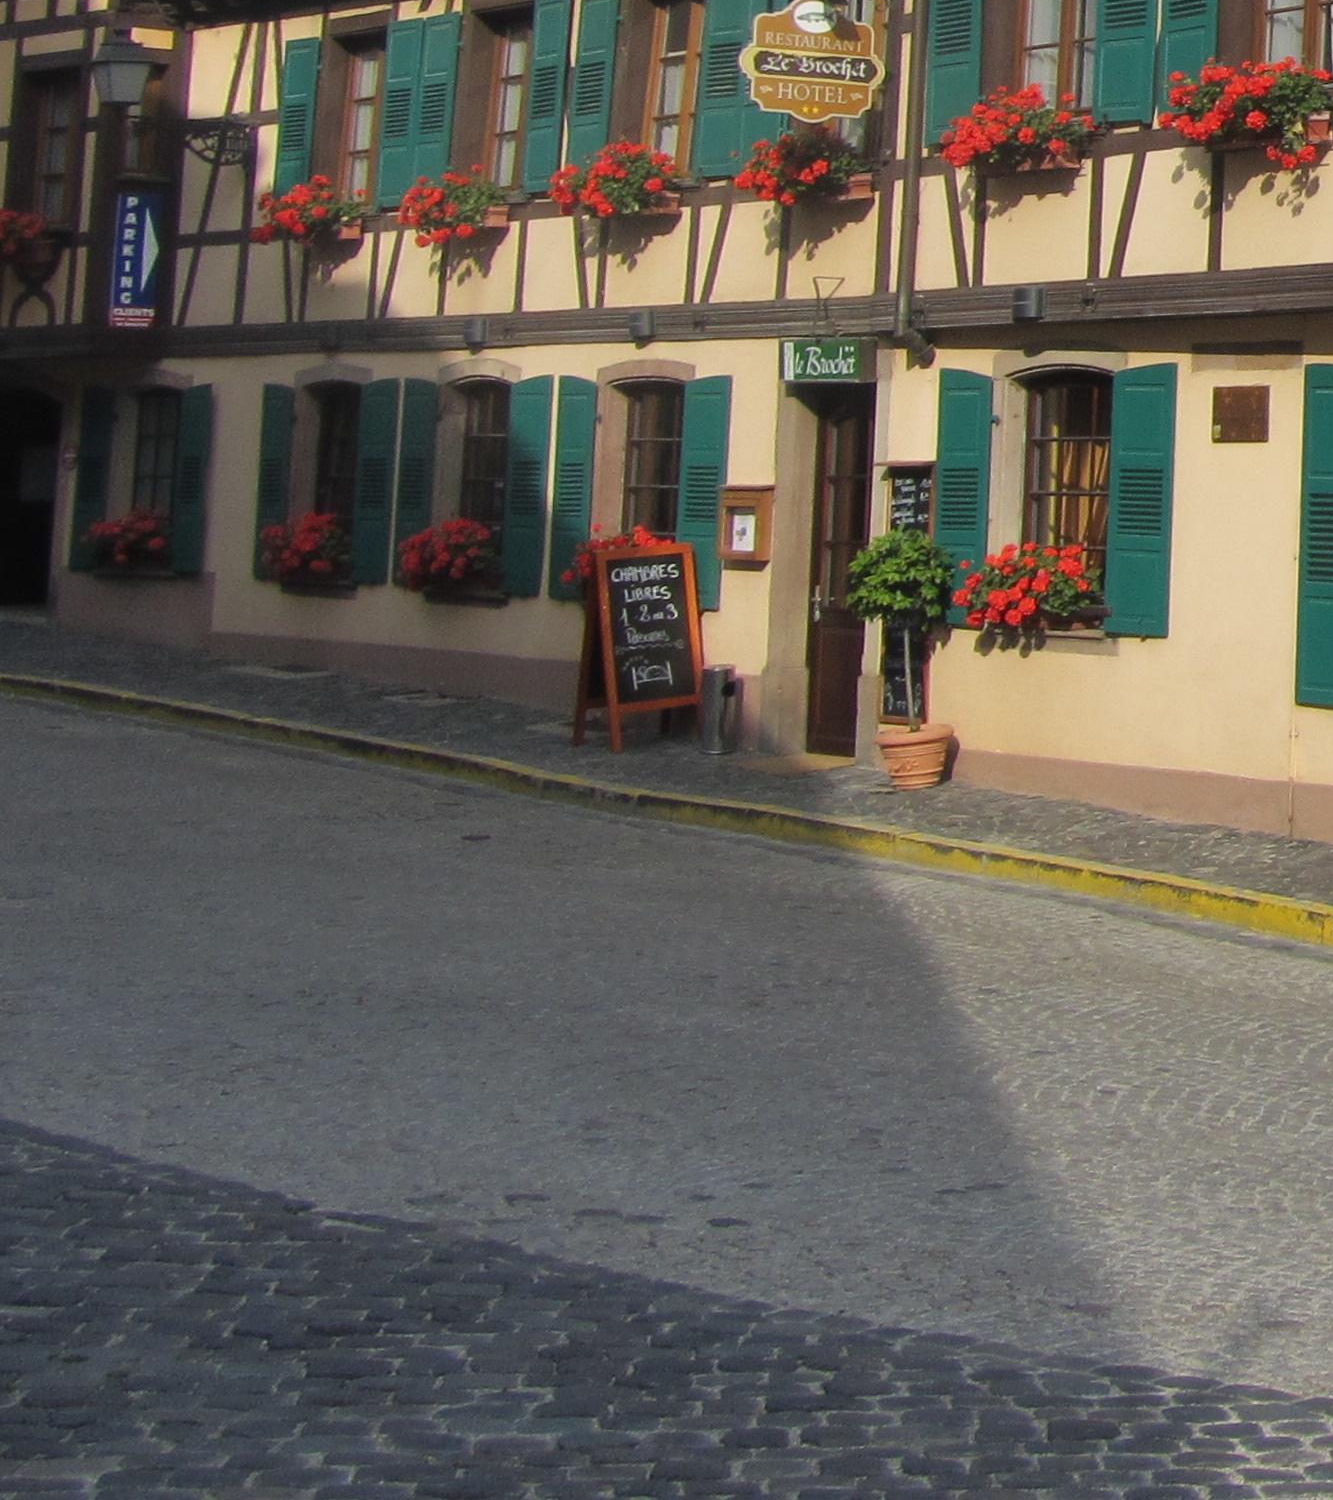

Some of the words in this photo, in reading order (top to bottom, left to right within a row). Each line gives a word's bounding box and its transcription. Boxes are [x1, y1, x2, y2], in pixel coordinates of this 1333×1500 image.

[765, 31, 864, 52] RESTAURANT
[761, 52, 794, 71] Le
[798, 56, 867, 81] Brochet
[777, 83, 848, 104] HOTEL
[120, 196, 139, 304] PARKING
[112, 308, 155, 318] CLIENTS
[611, 562, 680, 583] CHAMBRES
[666, 602, 679, 621] 3
